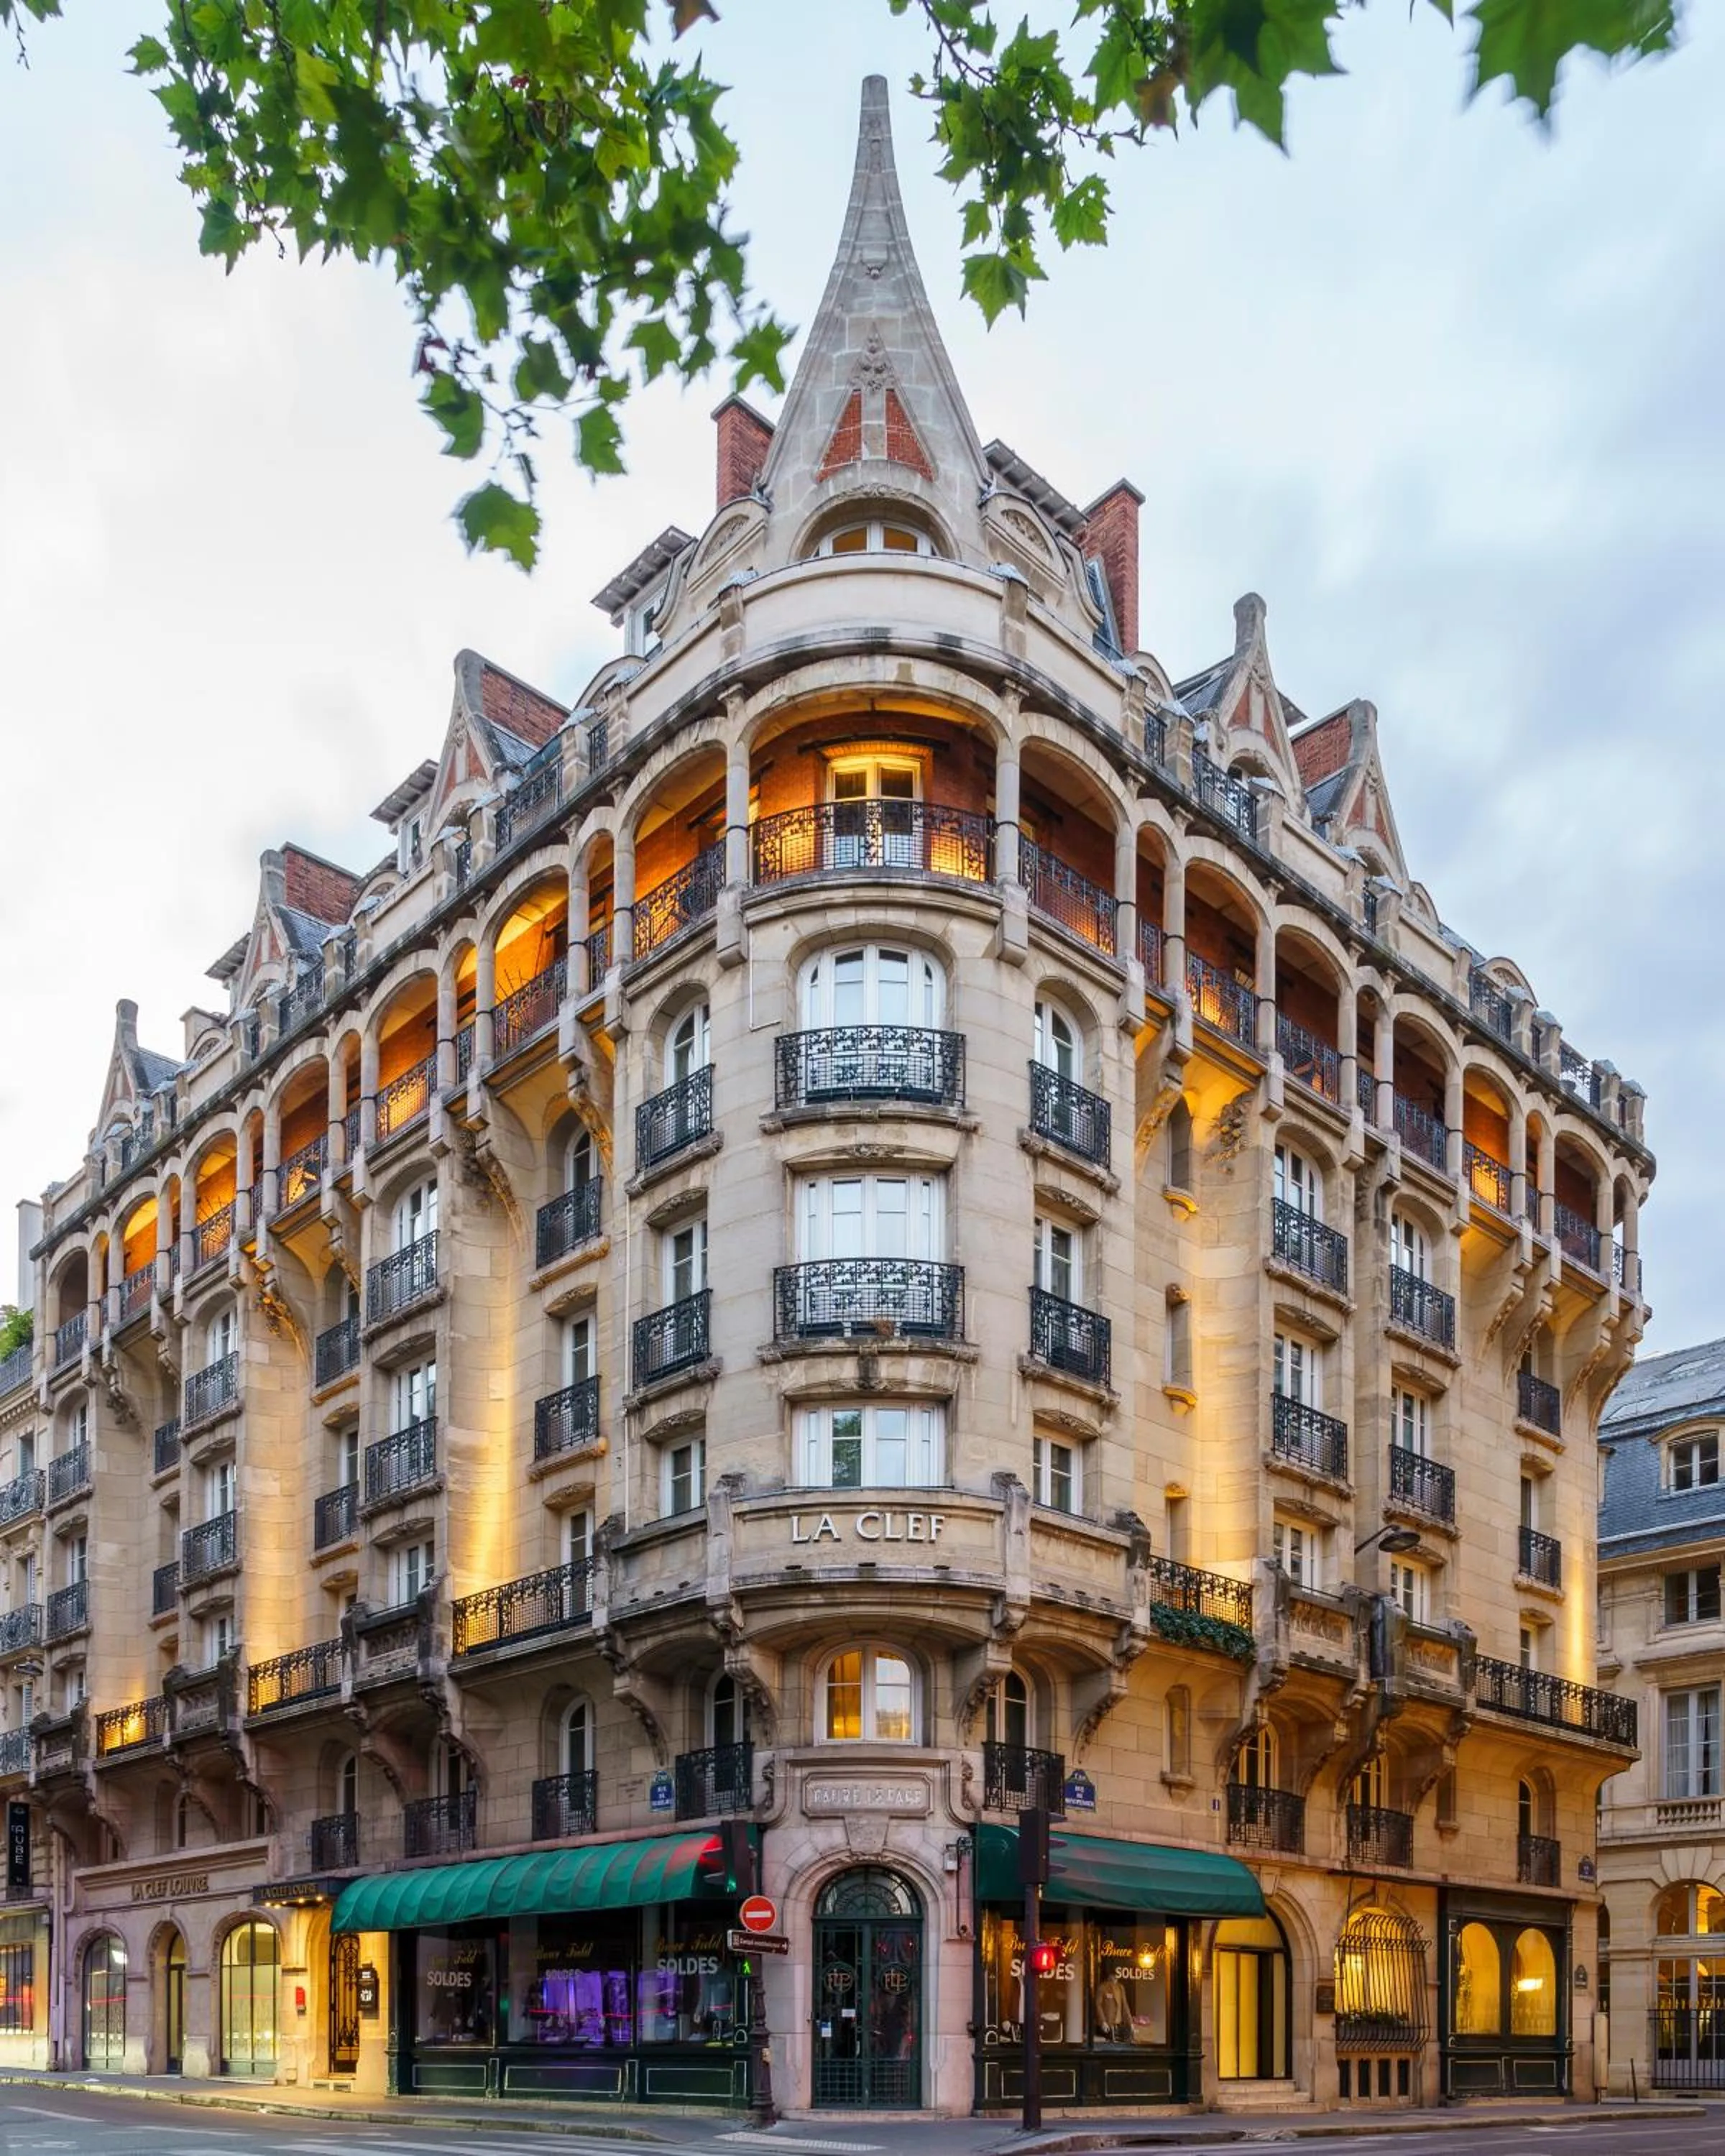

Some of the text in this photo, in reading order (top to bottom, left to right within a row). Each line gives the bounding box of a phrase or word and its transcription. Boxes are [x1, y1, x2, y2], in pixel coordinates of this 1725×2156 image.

[792, 1511, 945, 1543] LA CLEF
[132, 1883, 144, 1902] LA
[144, 1879, 168, 1899] CLEF
[1100, 1940, 1133, 1957] Bruce
[657, 1956, 719, 1976] SOLDES
[1011, 1958, 1075, 1981] SDES
[1115, 1966, 1155, 1980] SOLDES
[426, 1970, 472, 1987] SOLDES
